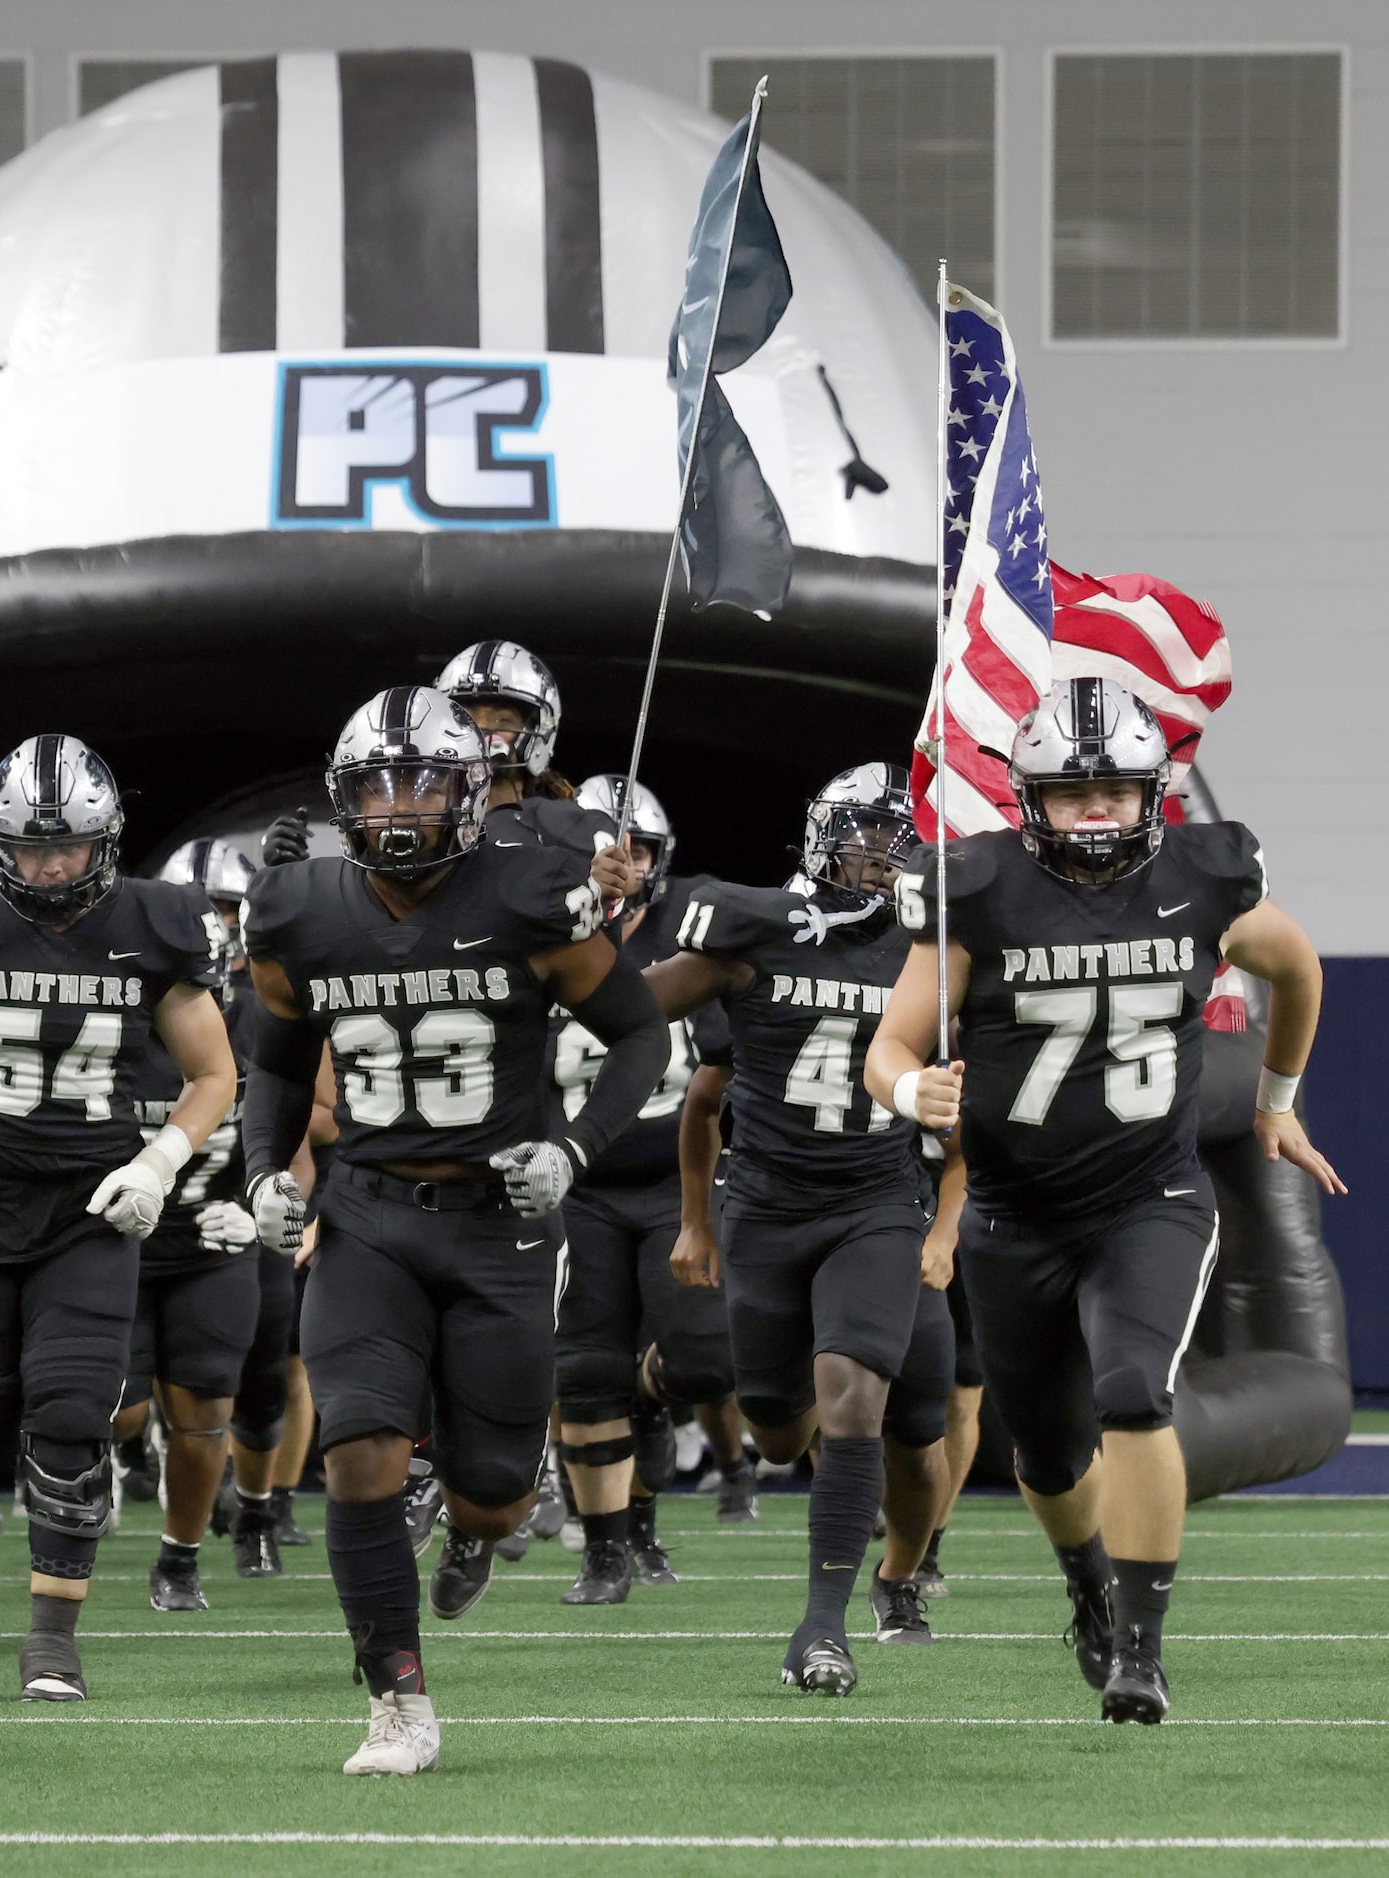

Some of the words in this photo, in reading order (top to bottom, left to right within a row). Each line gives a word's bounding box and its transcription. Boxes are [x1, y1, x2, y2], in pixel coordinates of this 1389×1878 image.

[270, 360, 558, 530] PC
[309, 966, 510, 1012] PANTHERS
[1002, 936, 1195, 982] PANTHERS
[329, 1007, 497, 1129] 33
[1007, 981, 1185, 1125] 75
